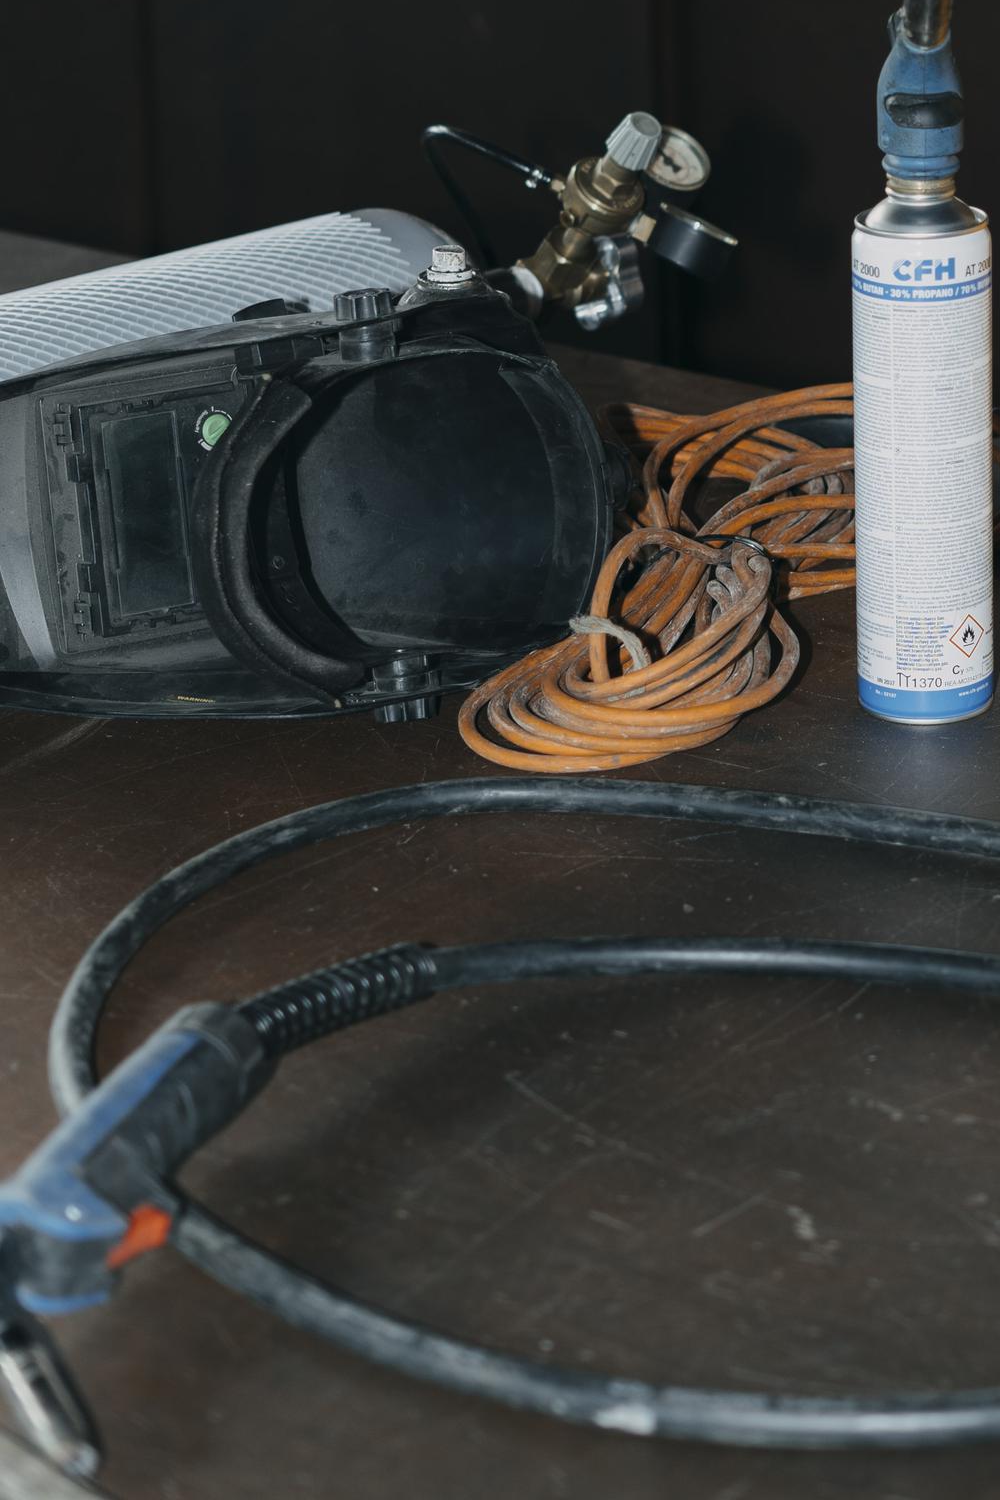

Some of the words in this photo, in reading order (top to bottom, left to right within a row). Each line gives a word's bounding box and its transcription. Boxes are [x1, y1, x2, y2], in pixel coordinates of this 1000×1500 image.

[860, 262, 880, 278] 2000
[892, 257, 956, 282] CFH
[965, 263, 976, 277] AT
[890, 287, 911, 299] 30%
[912, 288, 954, 299] PROPANO
